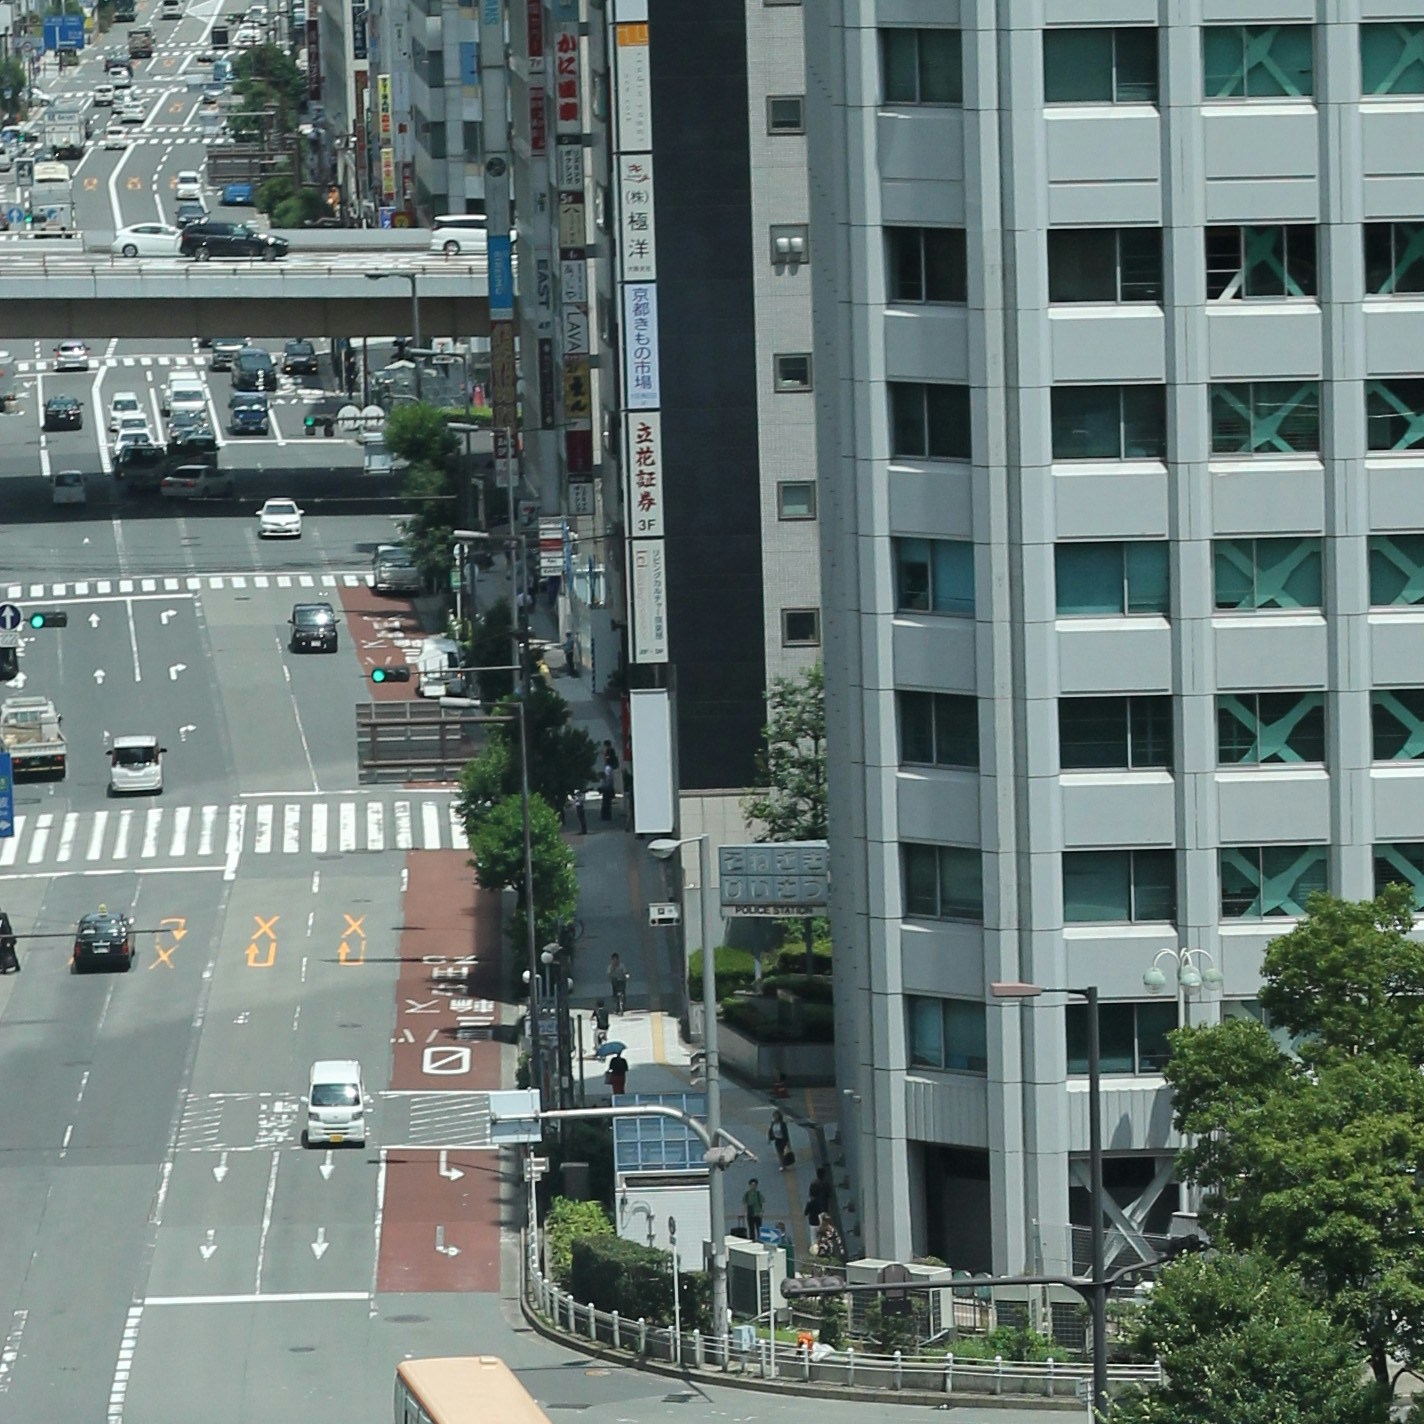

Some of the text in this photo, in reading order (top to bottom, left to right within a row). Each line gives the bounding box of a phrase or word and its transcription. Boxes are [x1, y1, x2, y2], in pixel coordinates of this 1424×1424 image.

[567, 312, 582, 352] LAVA
[632, 287, 652, 390] 京都きもの市場
[635, 422, 656, 512] 立花証券
[638, 519, 656, 531] 3F
[735, 904, 813, 914] POLICE STATION
